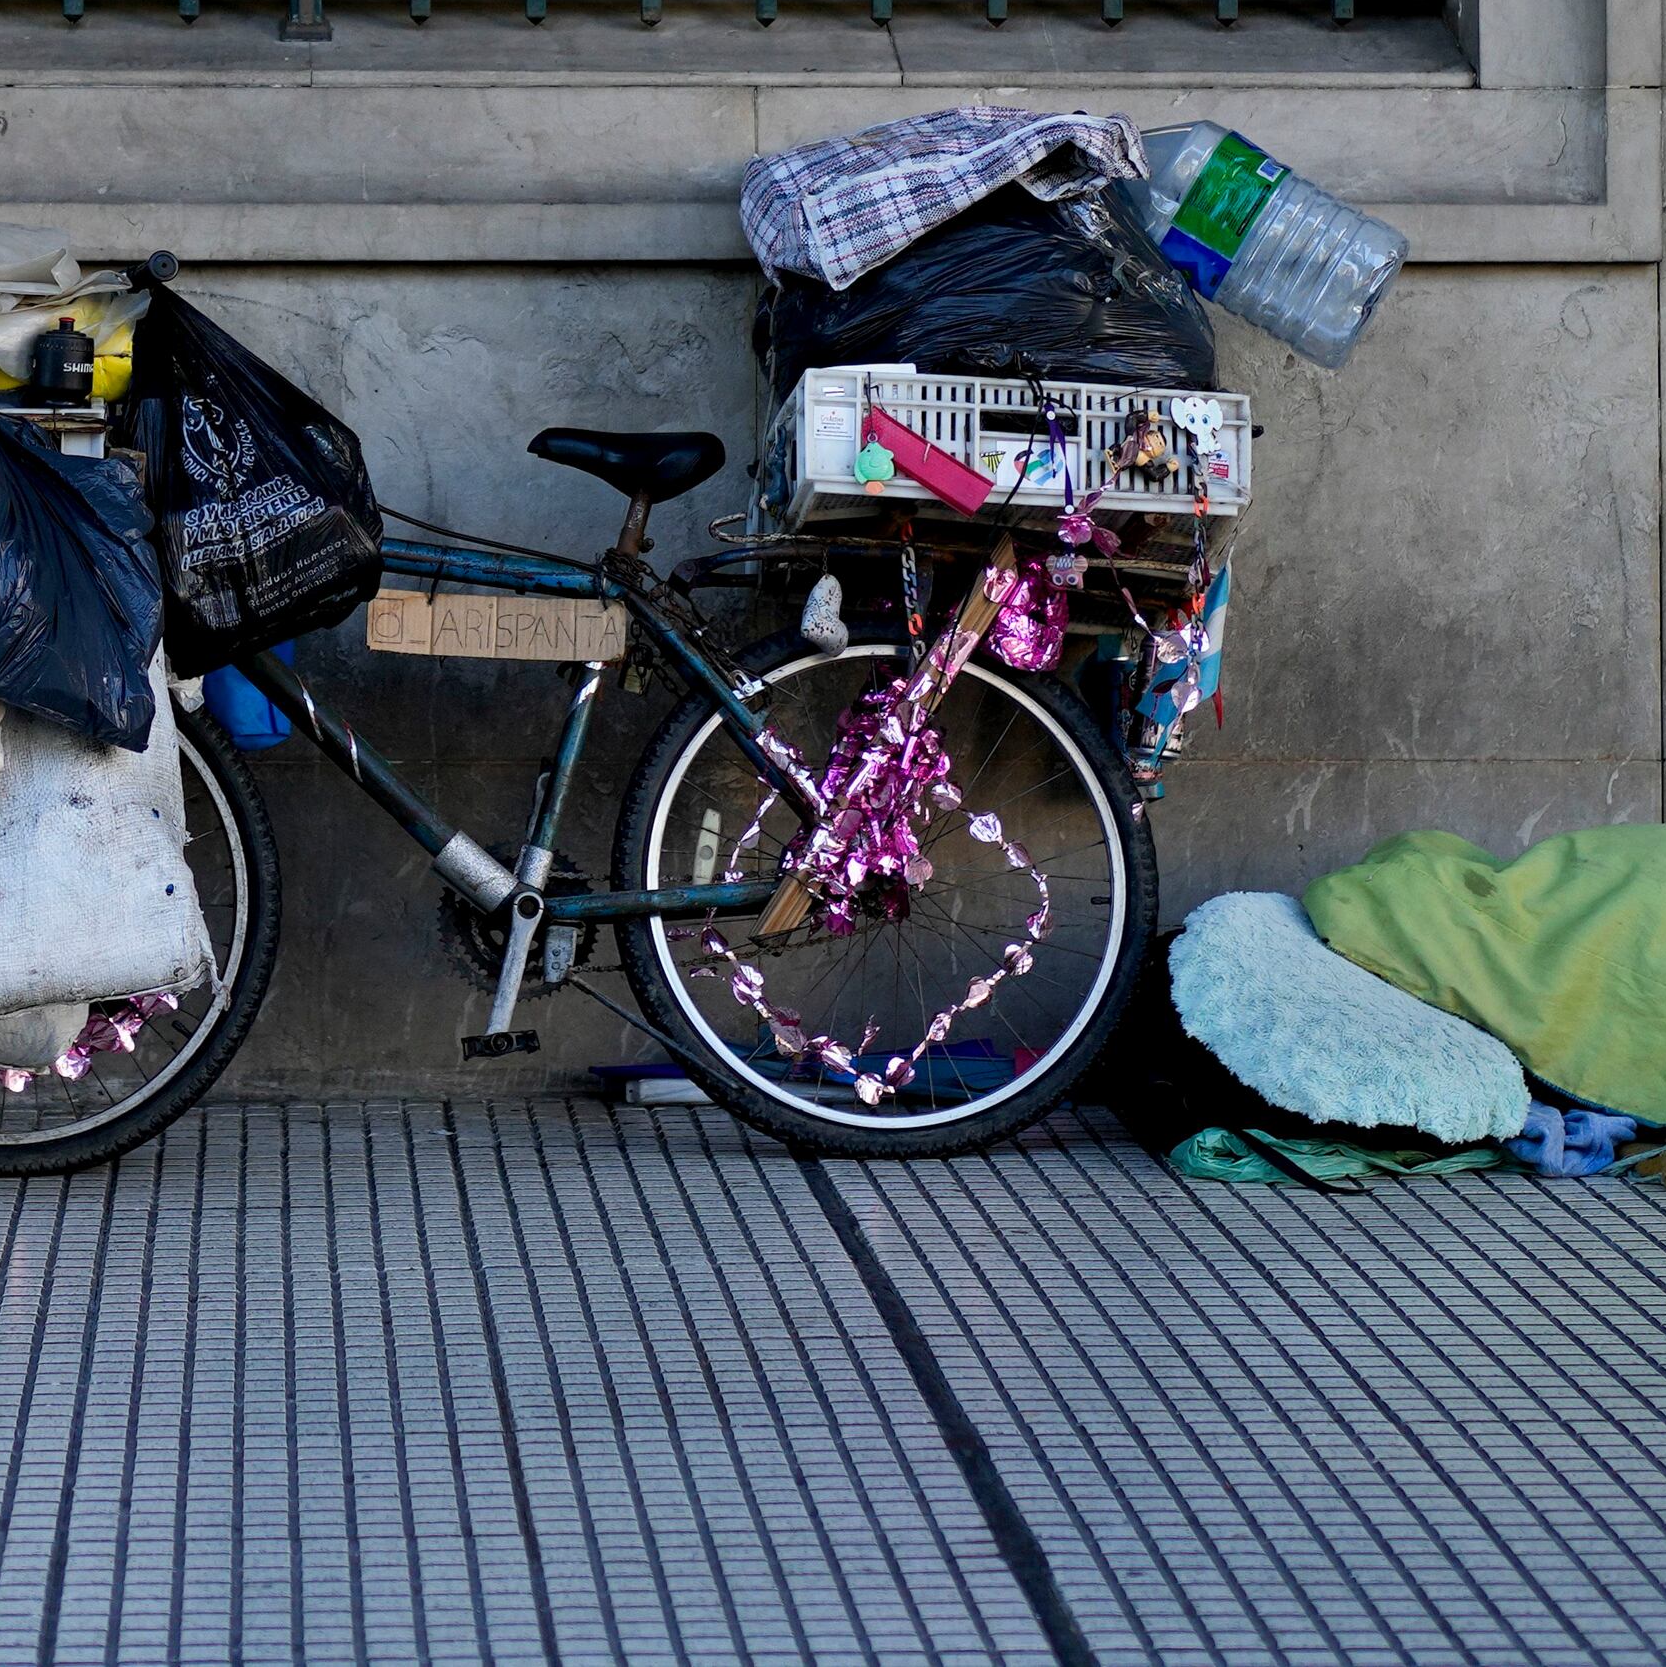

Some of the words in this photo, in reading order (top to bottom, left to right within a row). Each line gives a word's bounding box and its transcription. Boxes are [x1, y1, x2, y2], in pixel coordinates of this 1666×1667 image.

[184, 502, 218, 527] SOY
[237, 474, 295, 513] GRANDE
[274, 517, 291, 538] EL
[289, 496, 326, 528] TOPE!
[183, 527, 198, 547] Y
[259, 597, 291, 618] Restos
